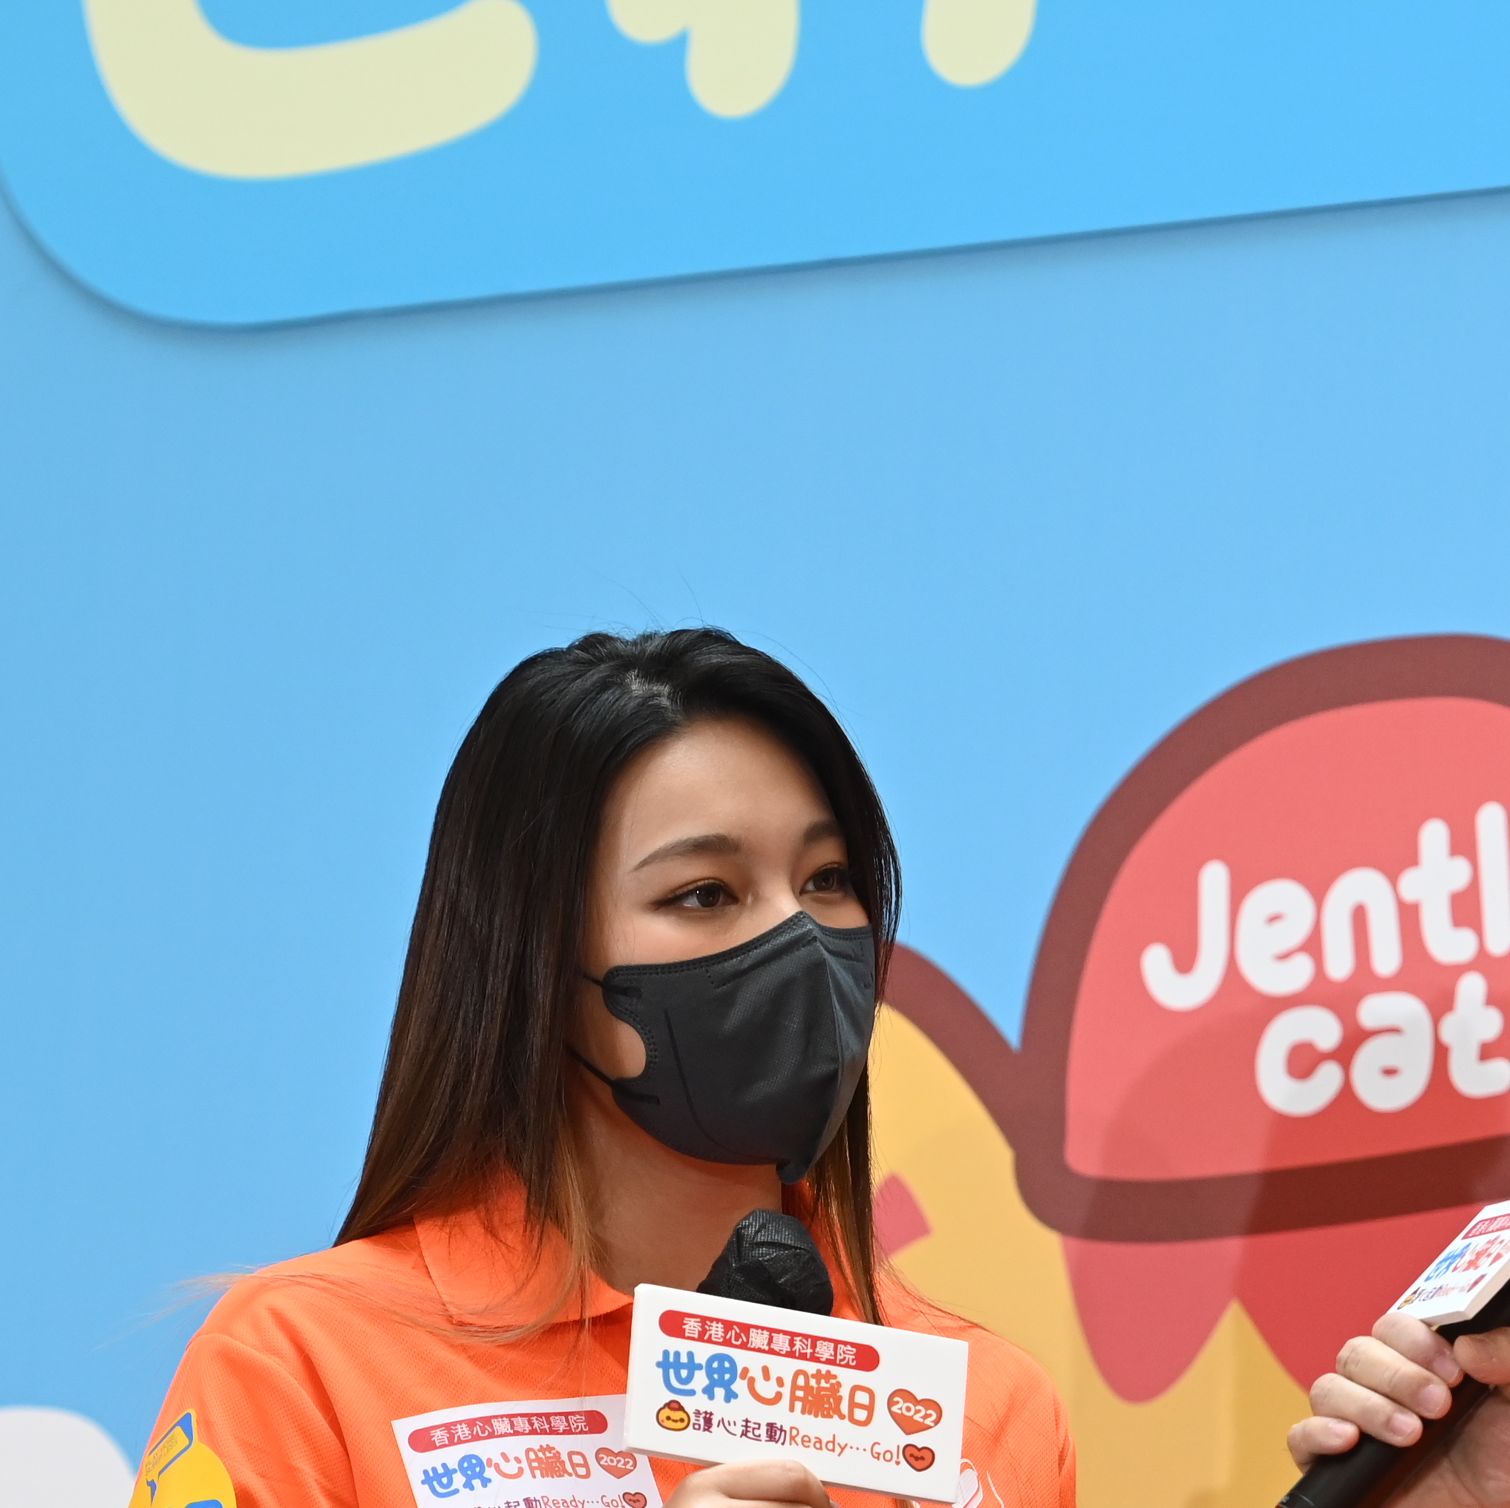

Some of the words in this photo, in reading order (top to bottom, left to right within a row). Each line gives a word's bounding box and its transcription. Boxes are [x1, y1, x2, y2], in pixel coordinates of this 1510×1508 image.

[681, 1316, 857, 1367] 香港心臟專科學院
[655, 1348, 876, 1427] 世界心臟日
[430, 1414, 589, 1447] 香港心臟專科學院
[692, 1408, 788, 1446] 護心起動
[891, 1396, 938, 1428] 2022
[421, 1444, 592, 1498] 世界心臟日
[598, 1454, 634, 1470] 2022
